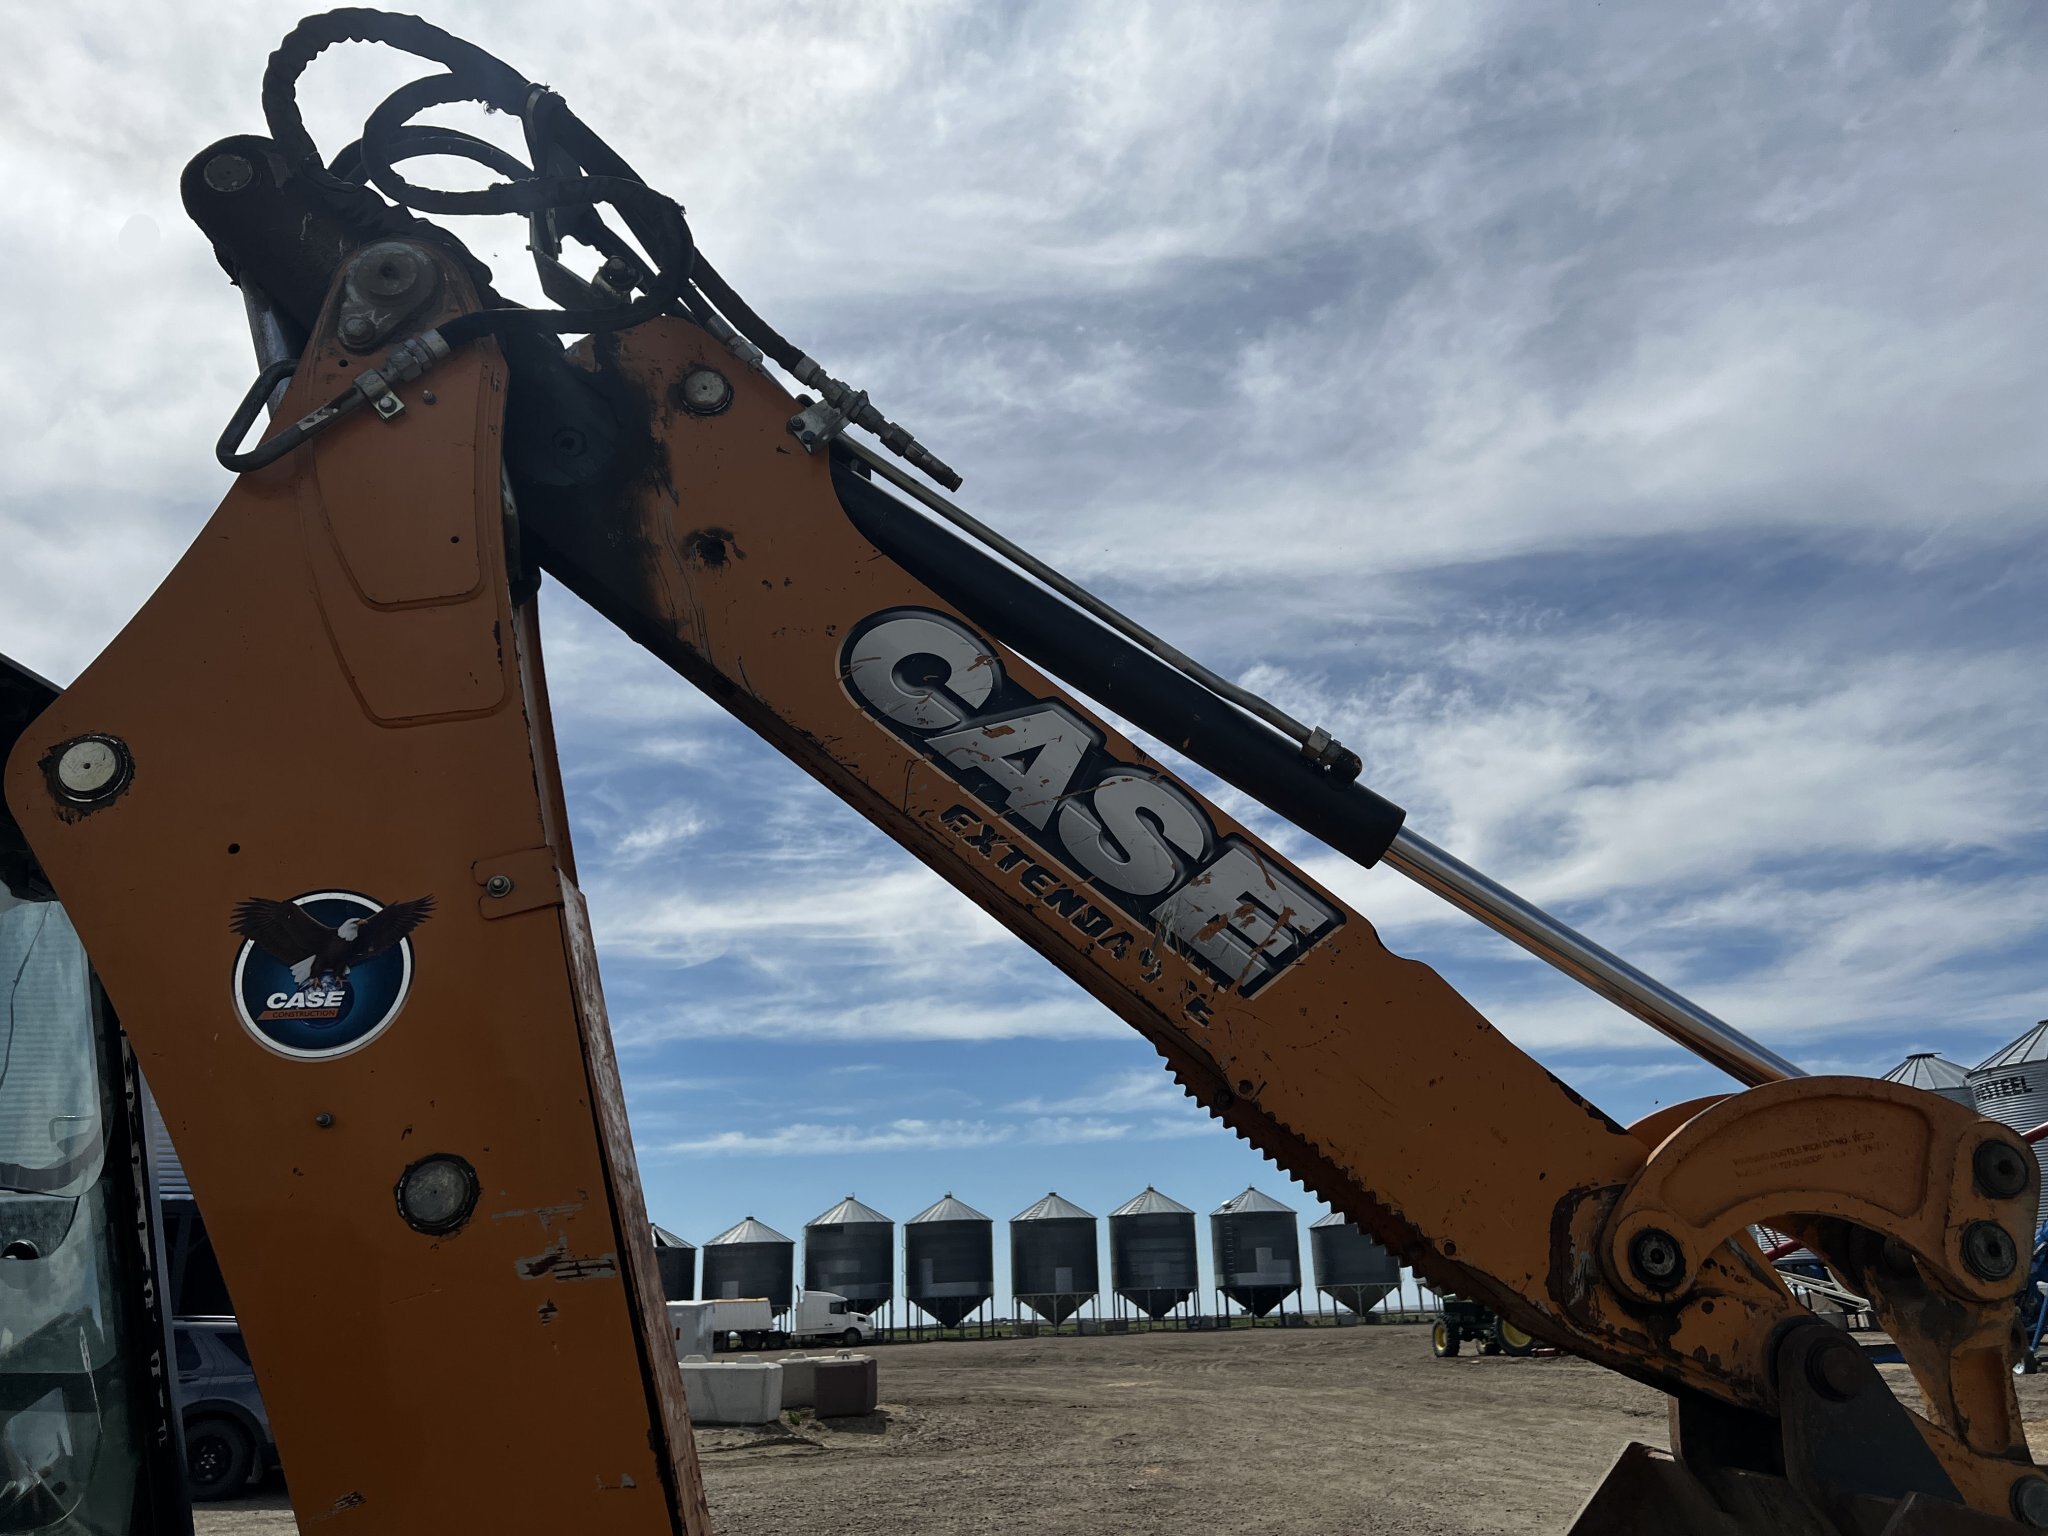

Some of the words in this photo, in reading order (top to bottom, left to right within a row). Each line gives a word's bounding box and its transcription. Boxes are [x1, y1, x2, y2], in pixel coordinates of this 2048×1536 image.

[848, 616, 1330, 988] CASE
[266, 990, 345, 1009] CASE
[272, 1009, 336, 1018] CONSTRUCTION
